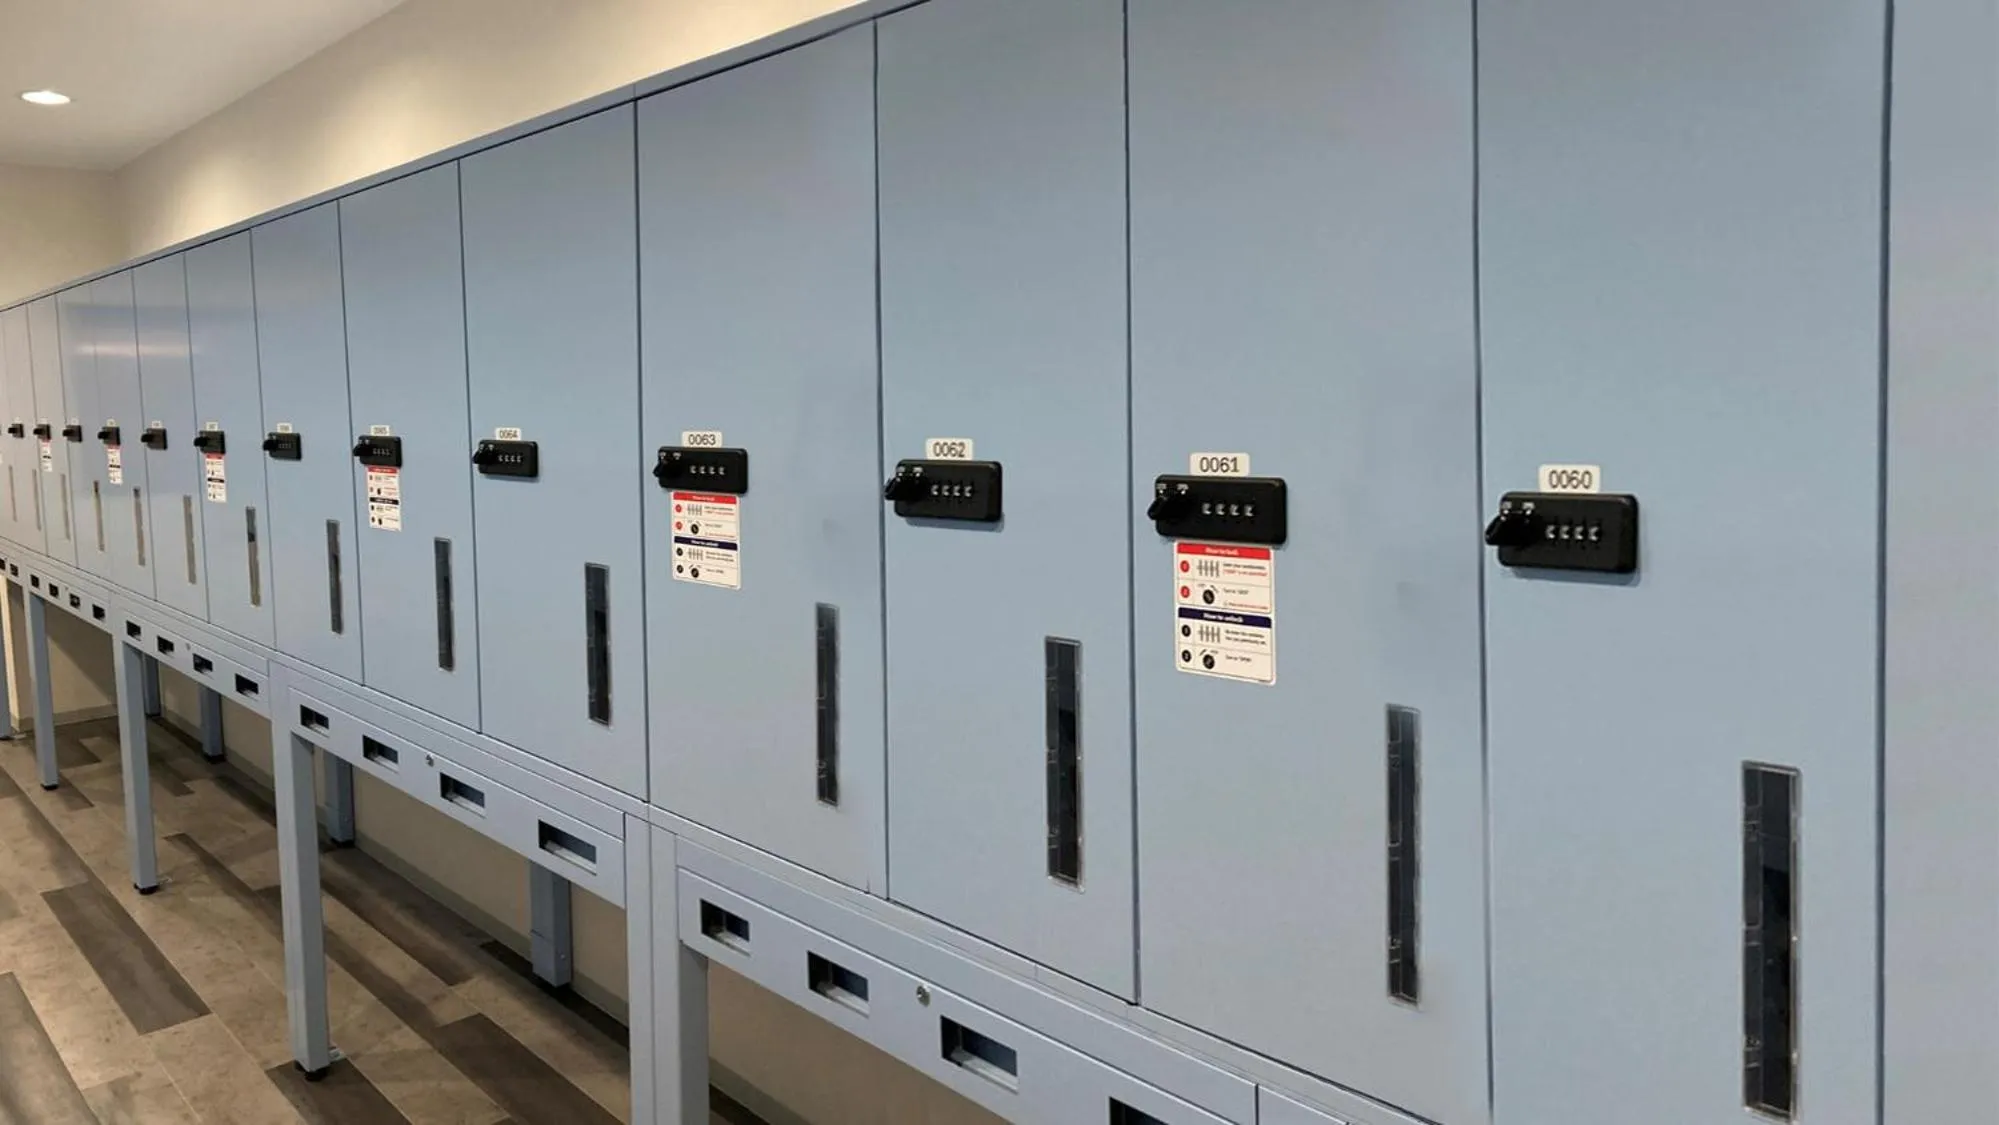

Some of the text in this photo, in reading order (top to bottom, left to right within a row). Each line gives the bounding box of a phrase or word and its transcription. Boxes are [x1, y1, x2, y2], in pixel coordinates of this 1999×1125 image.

[499, 429, 518, 439] 0064
[688, 434, 716, 446] 0063
[933, 442, 966, 458] 0062
[1199, 456, 1240, 474] 0061
[1549, 470, 1592, 489] 0060
